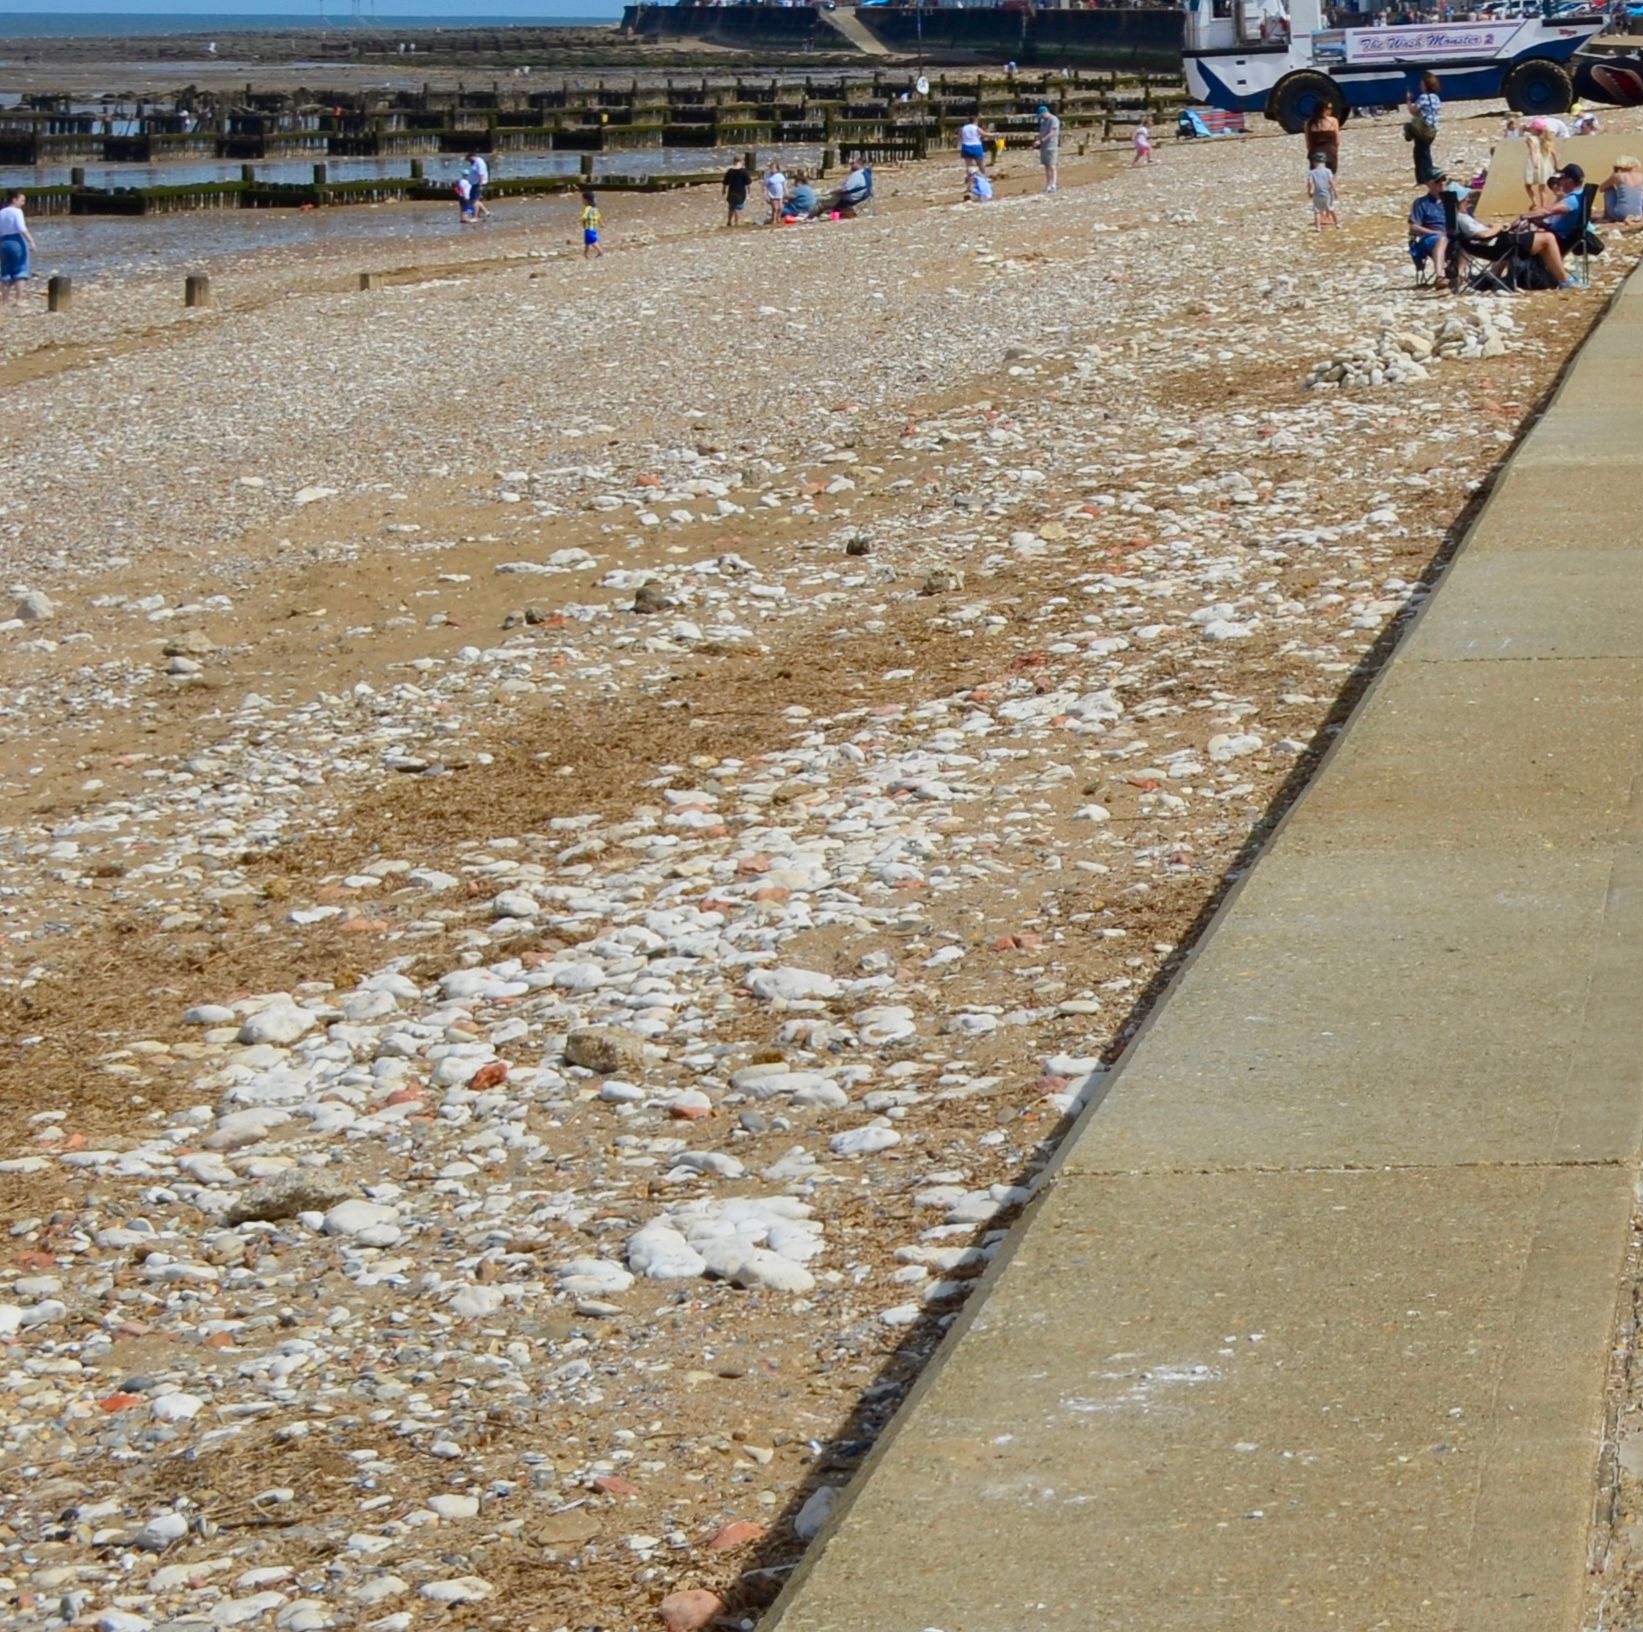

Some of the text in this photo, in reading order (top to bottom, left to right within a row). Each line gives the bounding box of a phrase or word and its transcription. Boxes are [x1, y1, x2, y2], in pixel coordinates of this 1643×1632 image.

[1360, 33, 1494, 51] The Wash Monster 2
